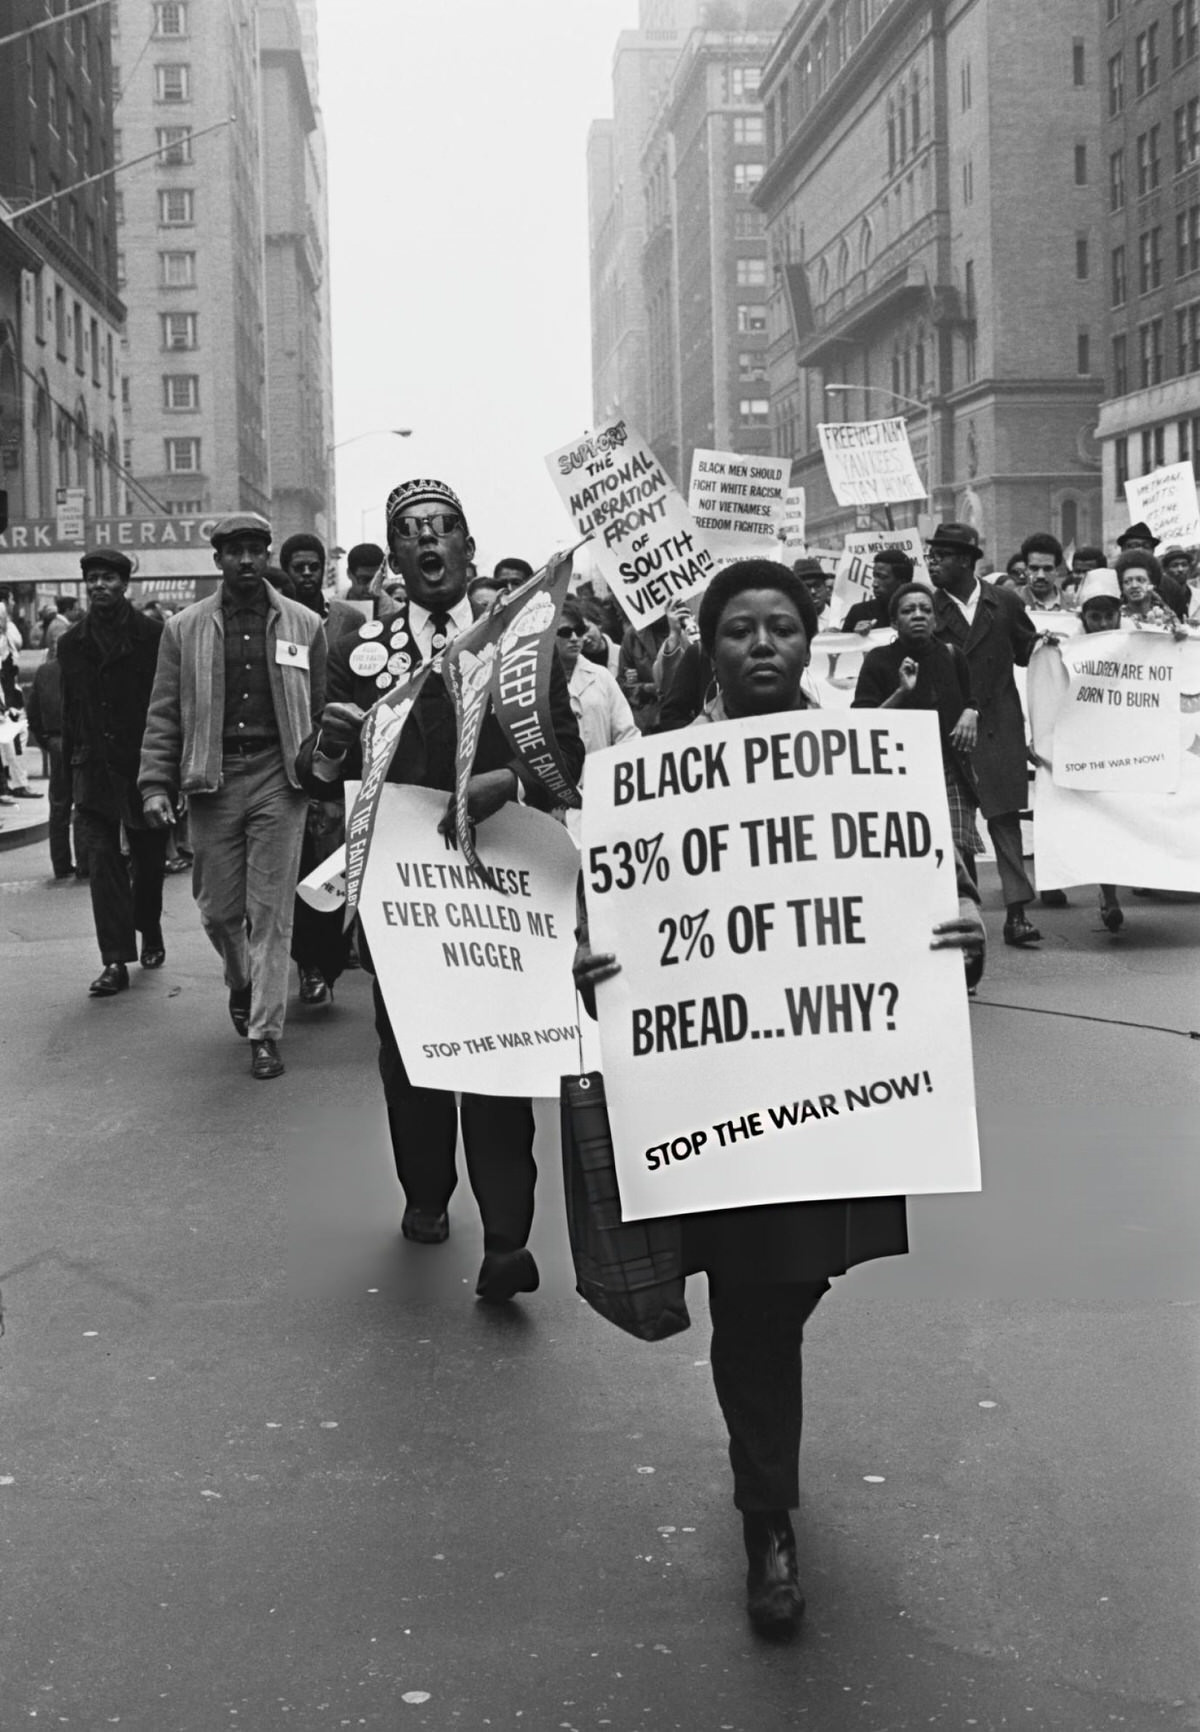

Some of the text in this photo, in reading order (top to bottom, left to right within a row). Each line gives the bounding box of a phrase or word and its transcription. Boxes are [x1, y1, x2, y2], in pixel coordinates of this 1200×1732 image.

[585, 452, 614, 477] THE
[699, 461, 782, 480] BLACK MEN SHOULD
[570, 451, 654, 516] NATIONAL
[693, 480, 716, 492] FIGHT
[720, 482, 747, 496] WHITE
[604, 494, 667, 548] FRONT
[699, 499, 716, 511] NOT
[720, 501, 771, 517] VIETNAMESE
[74, 520, 218, 545] HERATO
[632, 533, 649, 552] OF
[692, 516, 731, 529] REEDOM
[734, 521, 774, 535] FIGHTERS
[619, 530, 693, 584] SOUTH
[500, 639, 540, 707] KEEP
[1073, 660, 1173, 681] CHILDREN ARE NOT
[1076, 686, 1159, 708] BORN TO BURN
[510, 711, 546, 754] THE
[528, 753, 566, 791] FAITH
[613, 728, 907, 806] BLACK PEOPLE:
[1065, 753, 1165, 772] STOP THE WAR NOW!
[350, 801, 373, 839] THE
[348, 838, 367, 879] FAITH
[589, 811, 945, 893] 53% OF THE DEAD,
[347, 879, 360, 906] BABY
[382, 901, 558, 939] EVER CALLED ME
[658, 896, 865, 966] 2% OF THE
[442, 942, 523, 972] NIGGER
[422, 1042, 461, 1058] STOP
[464, 1037, 496, 1053] THE
[497, 1032, 533, 1048] WAR
[645, 1071, 934, 1170] STOP THE WAR NOW!
